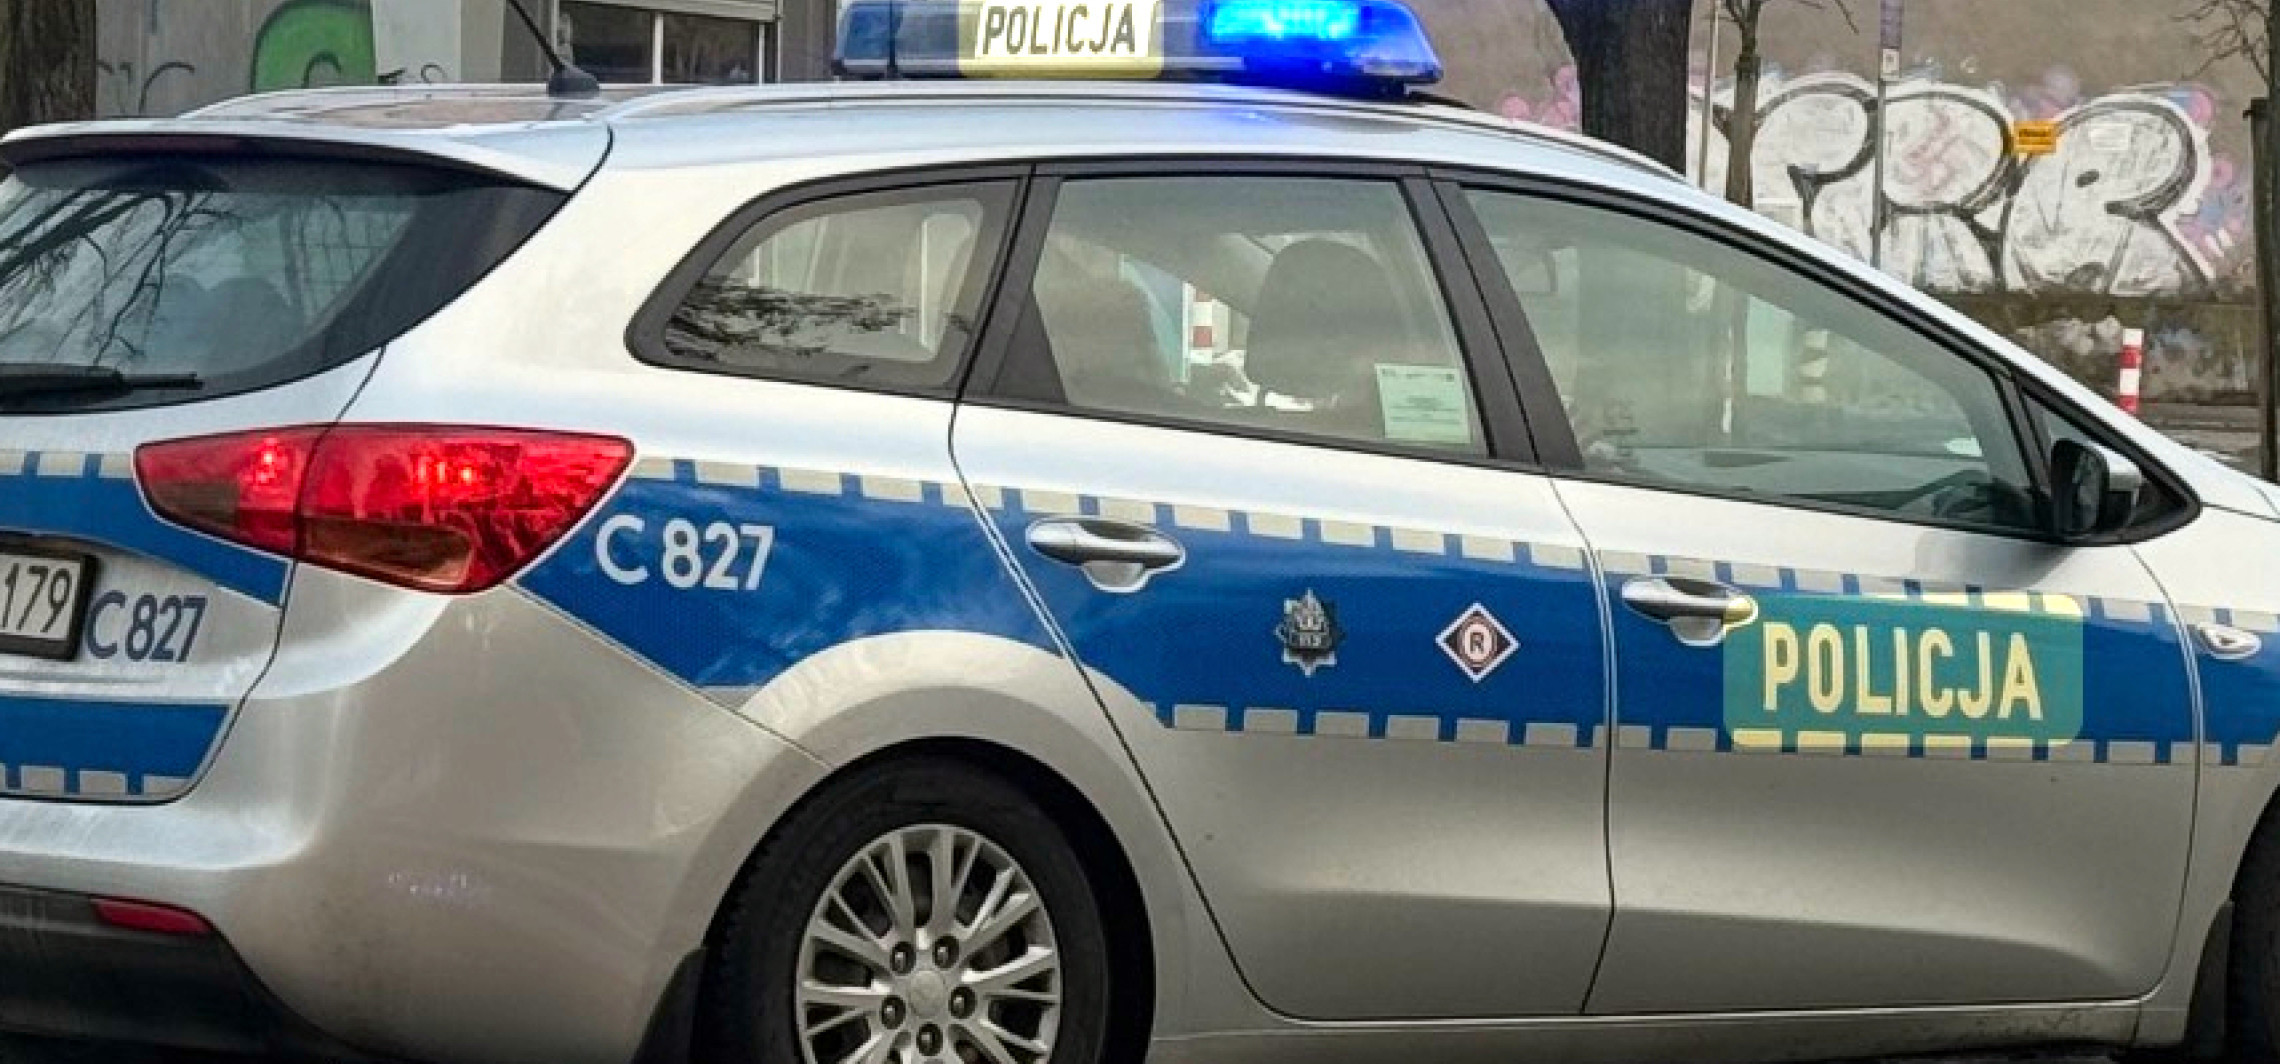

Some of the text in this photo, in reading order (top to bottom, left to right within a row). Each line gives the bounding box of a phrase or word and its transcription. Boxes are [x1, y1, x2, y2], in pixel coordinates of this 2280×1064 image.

[982, 3, 1136, 55] POLICJA
[596, 514, 775, 590] C 827
[2, 562, 72, 634] 179
[87, 590, 208, 662] C 827
[1469, 631, 1485, 653] R
[1762, 621, 2043, 720] POLICJA
